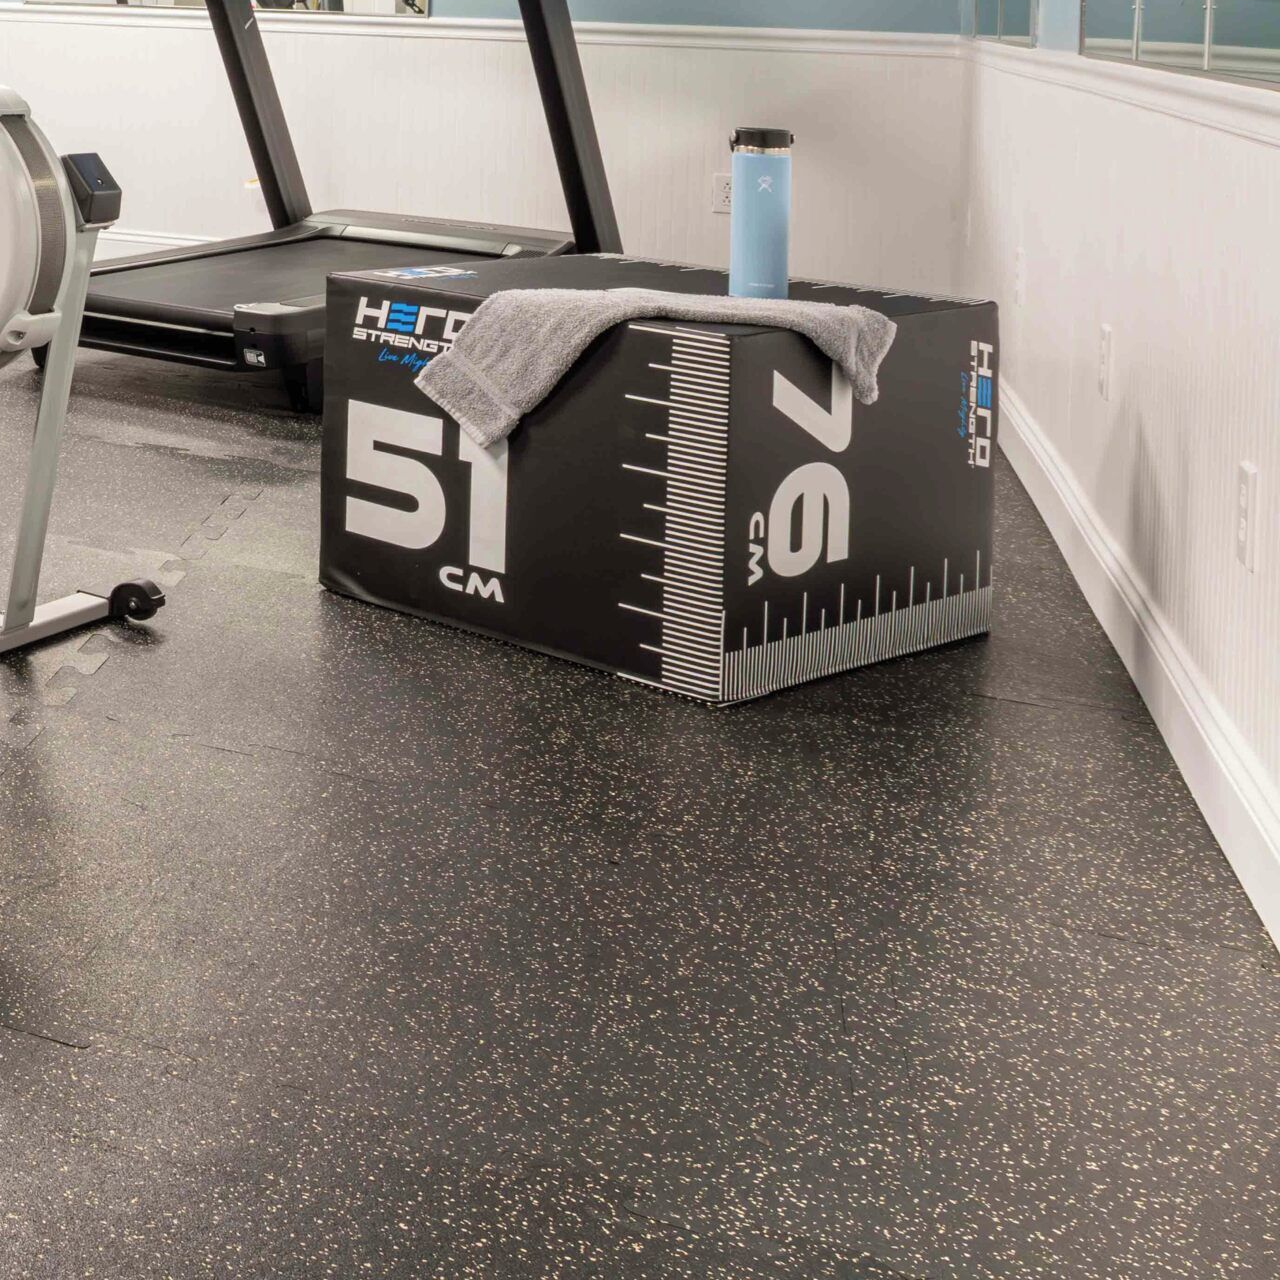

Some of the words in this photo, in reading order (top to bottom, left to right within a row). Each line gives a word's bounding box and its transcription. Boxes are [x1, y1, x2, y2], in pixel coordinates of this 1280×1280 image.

[352, 326, 454, 354] STRENGT
[345, 398, 509, 575] 51
[747, 511, 765, 587] CM
[439, 565, 505, 603] CM
